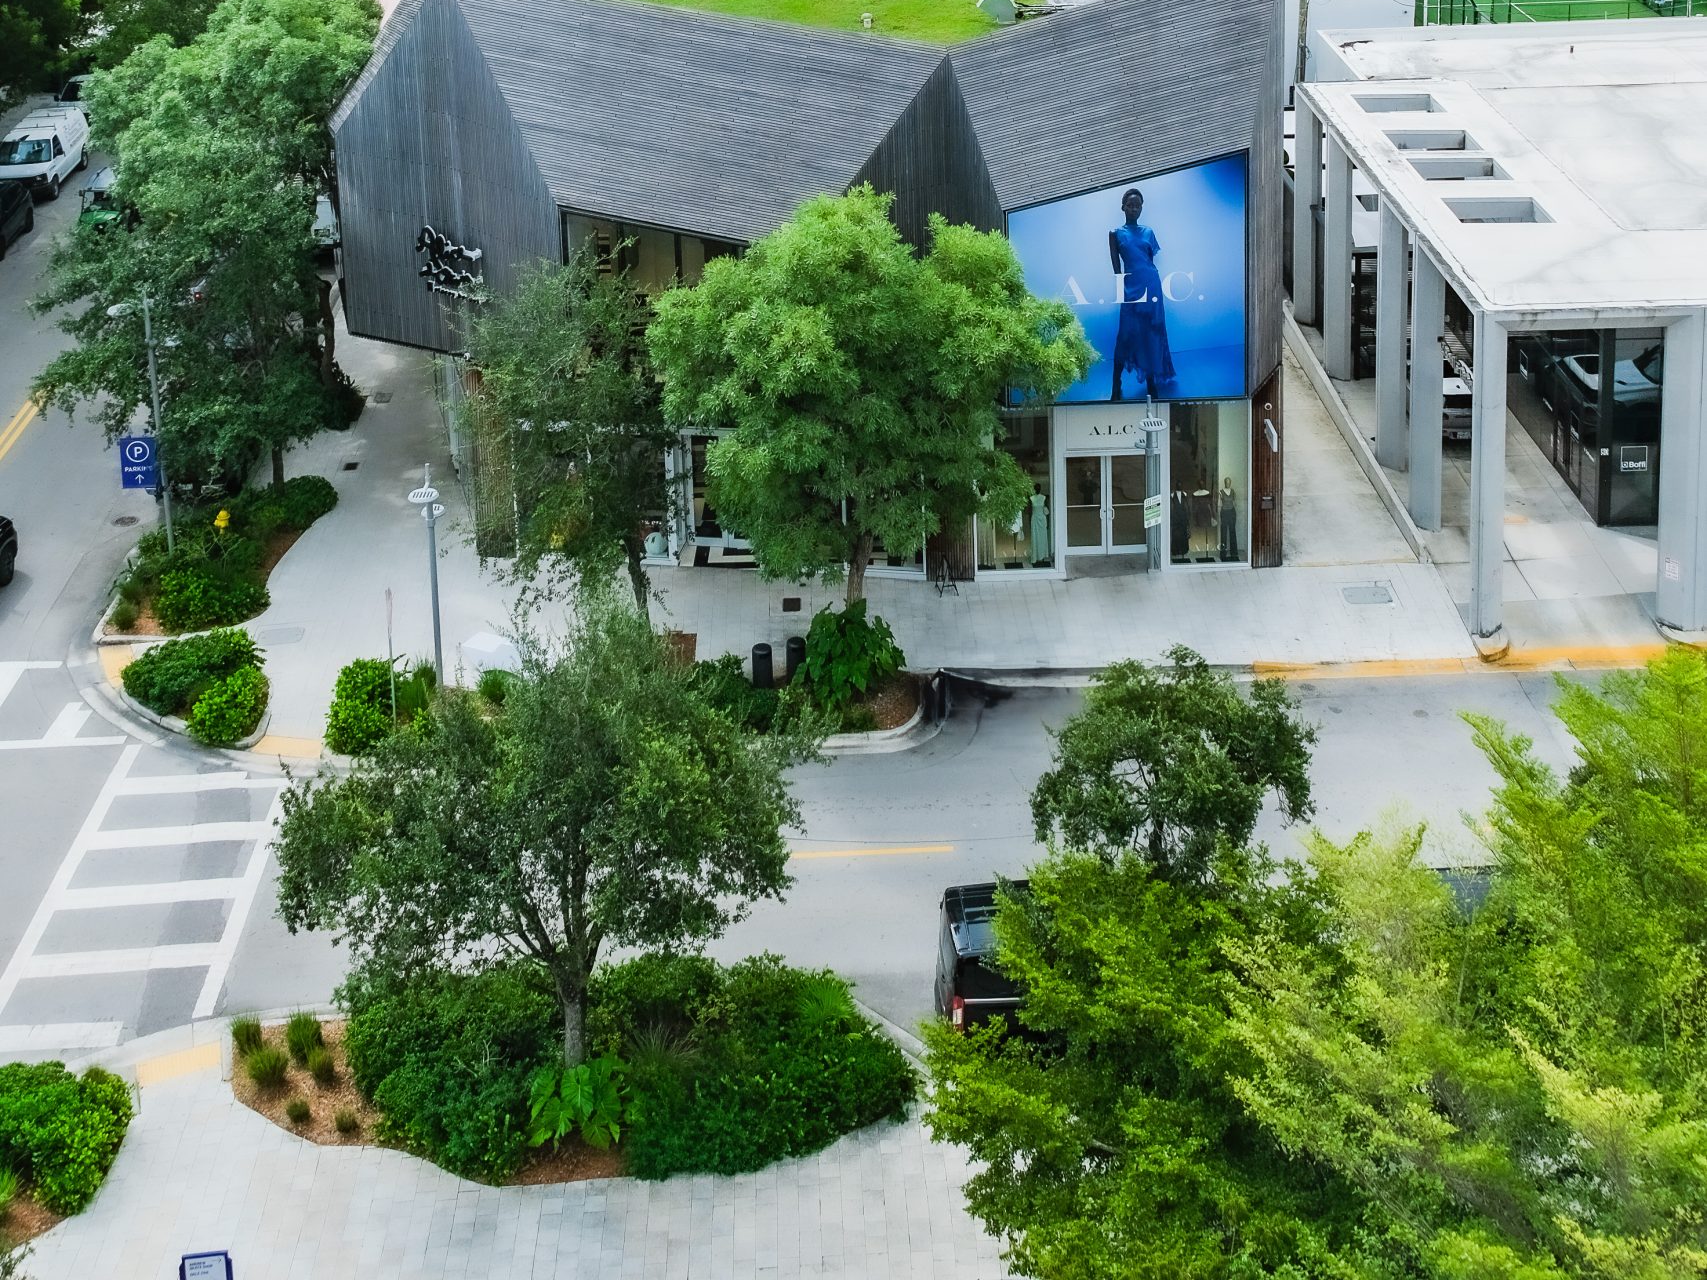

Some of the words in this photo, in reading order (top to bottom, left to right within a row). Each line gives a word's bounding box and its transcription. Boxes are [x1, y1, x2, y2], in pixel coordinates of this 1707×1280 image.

[1060, 271, 1204, 306] A.L.C.
[1089, 424, 1137, 436] A.L.C.
[134, 446, 143, 458] P
